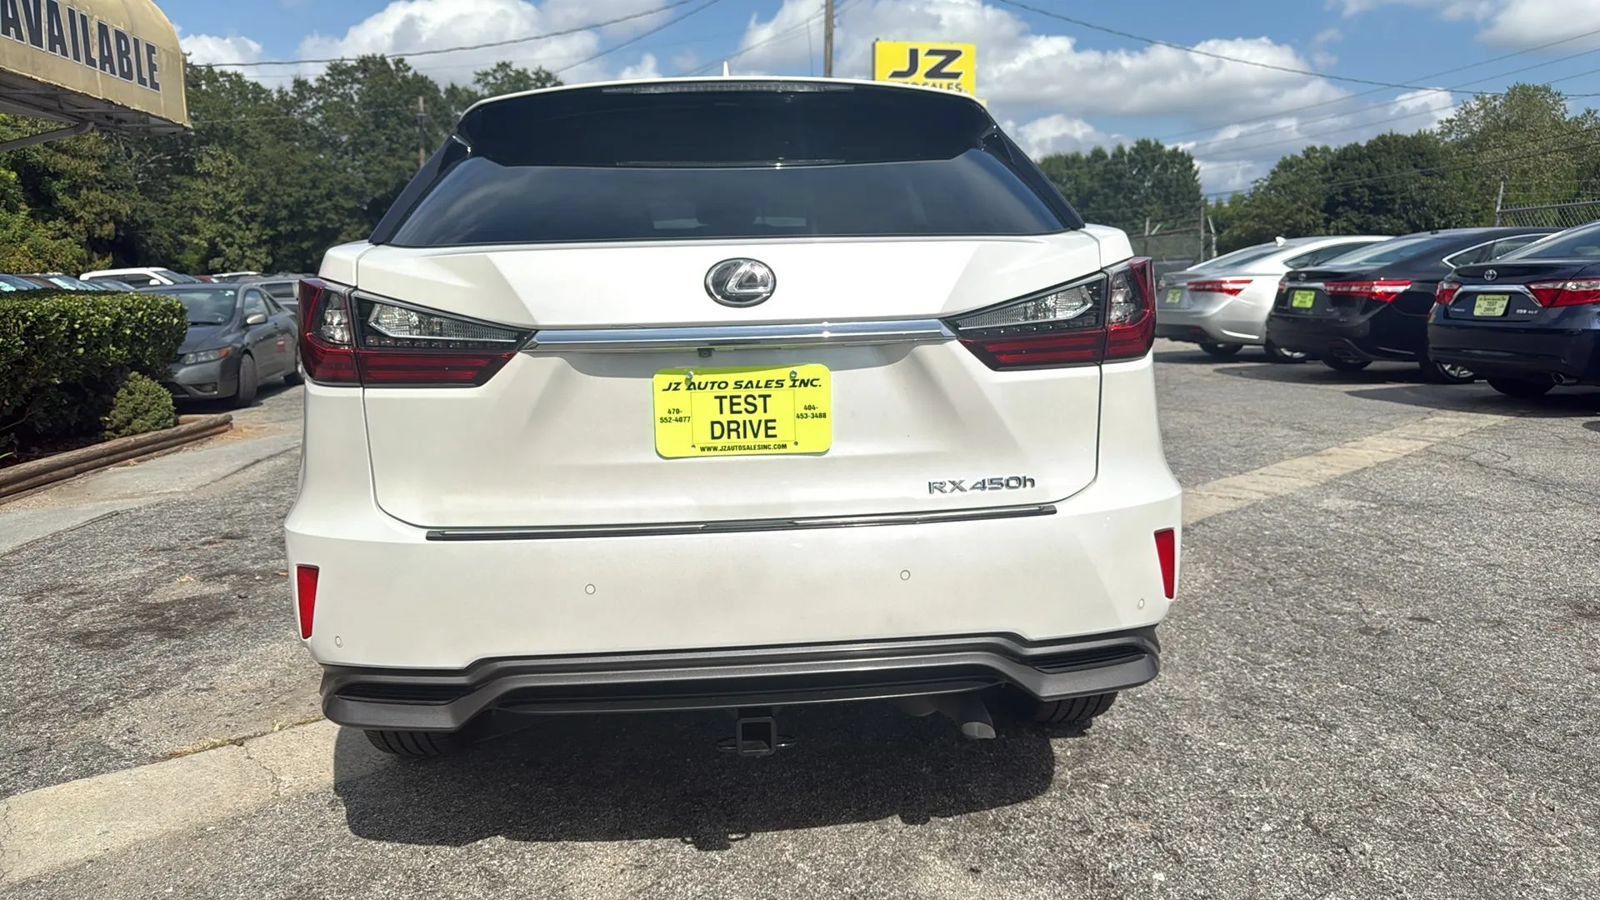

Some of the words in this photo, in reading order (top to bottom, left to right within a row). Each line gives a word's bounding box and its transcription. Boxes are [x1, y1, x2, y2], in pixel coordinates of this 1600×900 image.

[1, 0, 160, 92] AVAILABLE
[888, 48, 963, 79] JZ
[662, 382, 682, 391] JZ
[686, 380, 729, 391] AUTO
[733, 379, 785, 390] SALES
[790, 378, 822, 388] INC.
[714, 394, 772, 415] TEST
[710, 419, 778, 440] DRIVE
[700, 443, 787, 452] WWW.JZAUTOSALESINC.COM
